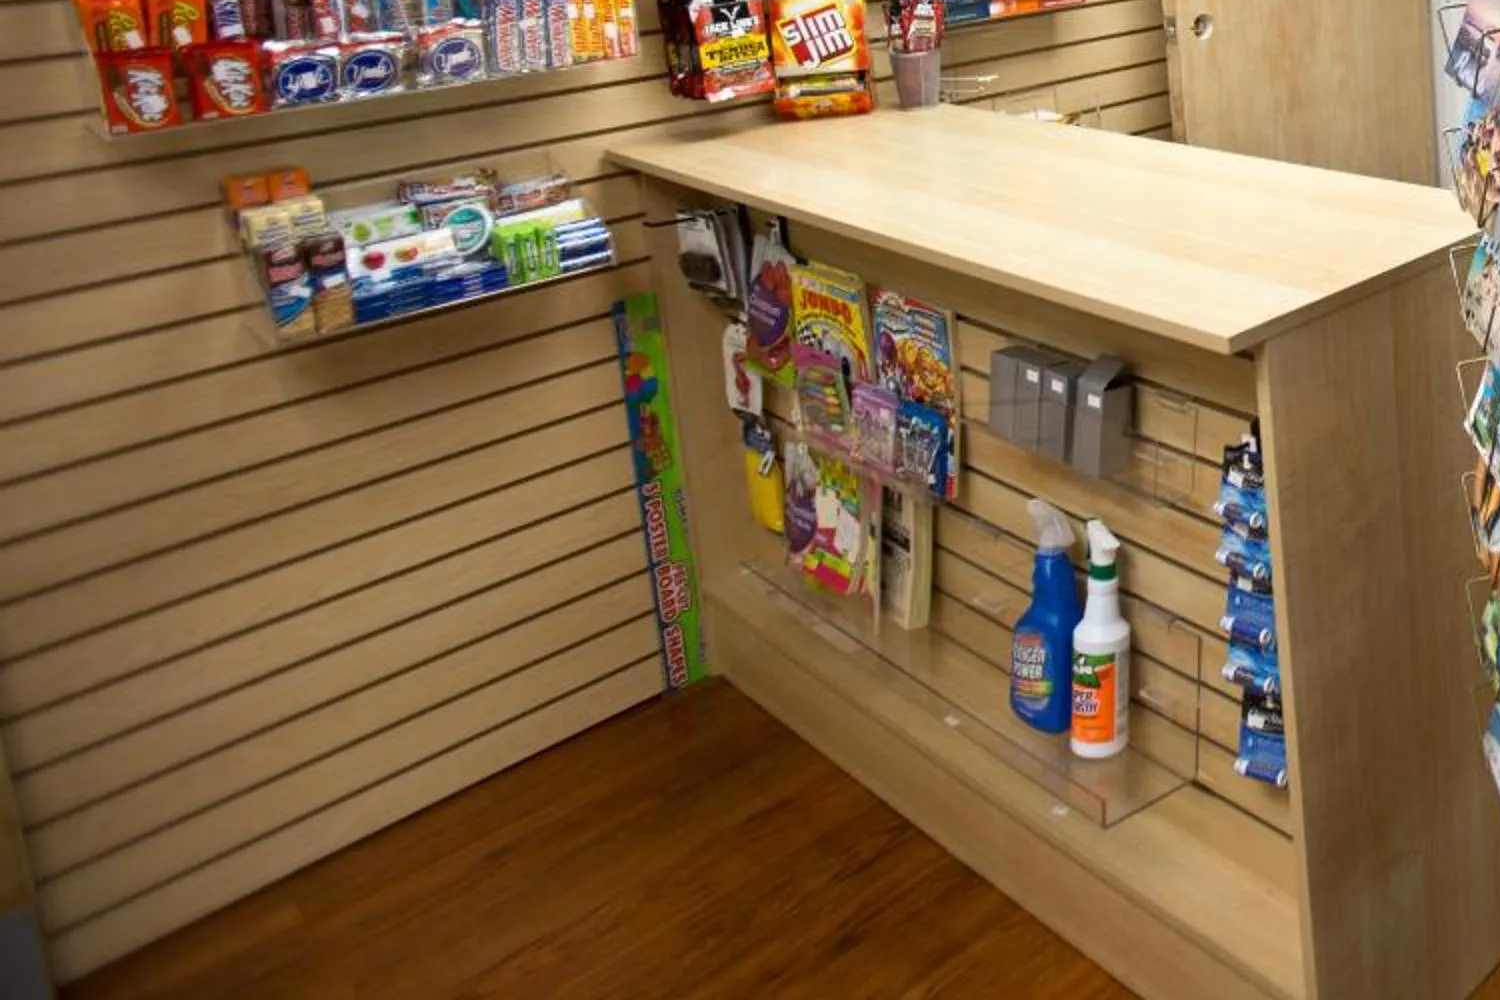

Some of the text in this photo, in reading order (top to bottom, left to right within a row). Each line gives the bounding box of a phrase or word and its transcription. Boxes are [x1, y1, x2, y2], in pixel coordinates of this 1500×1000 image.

[780, 10, 846, 46] slim
[644, 499, 669, 561] POSTER
[656, 562, 679, 623] BOARD
